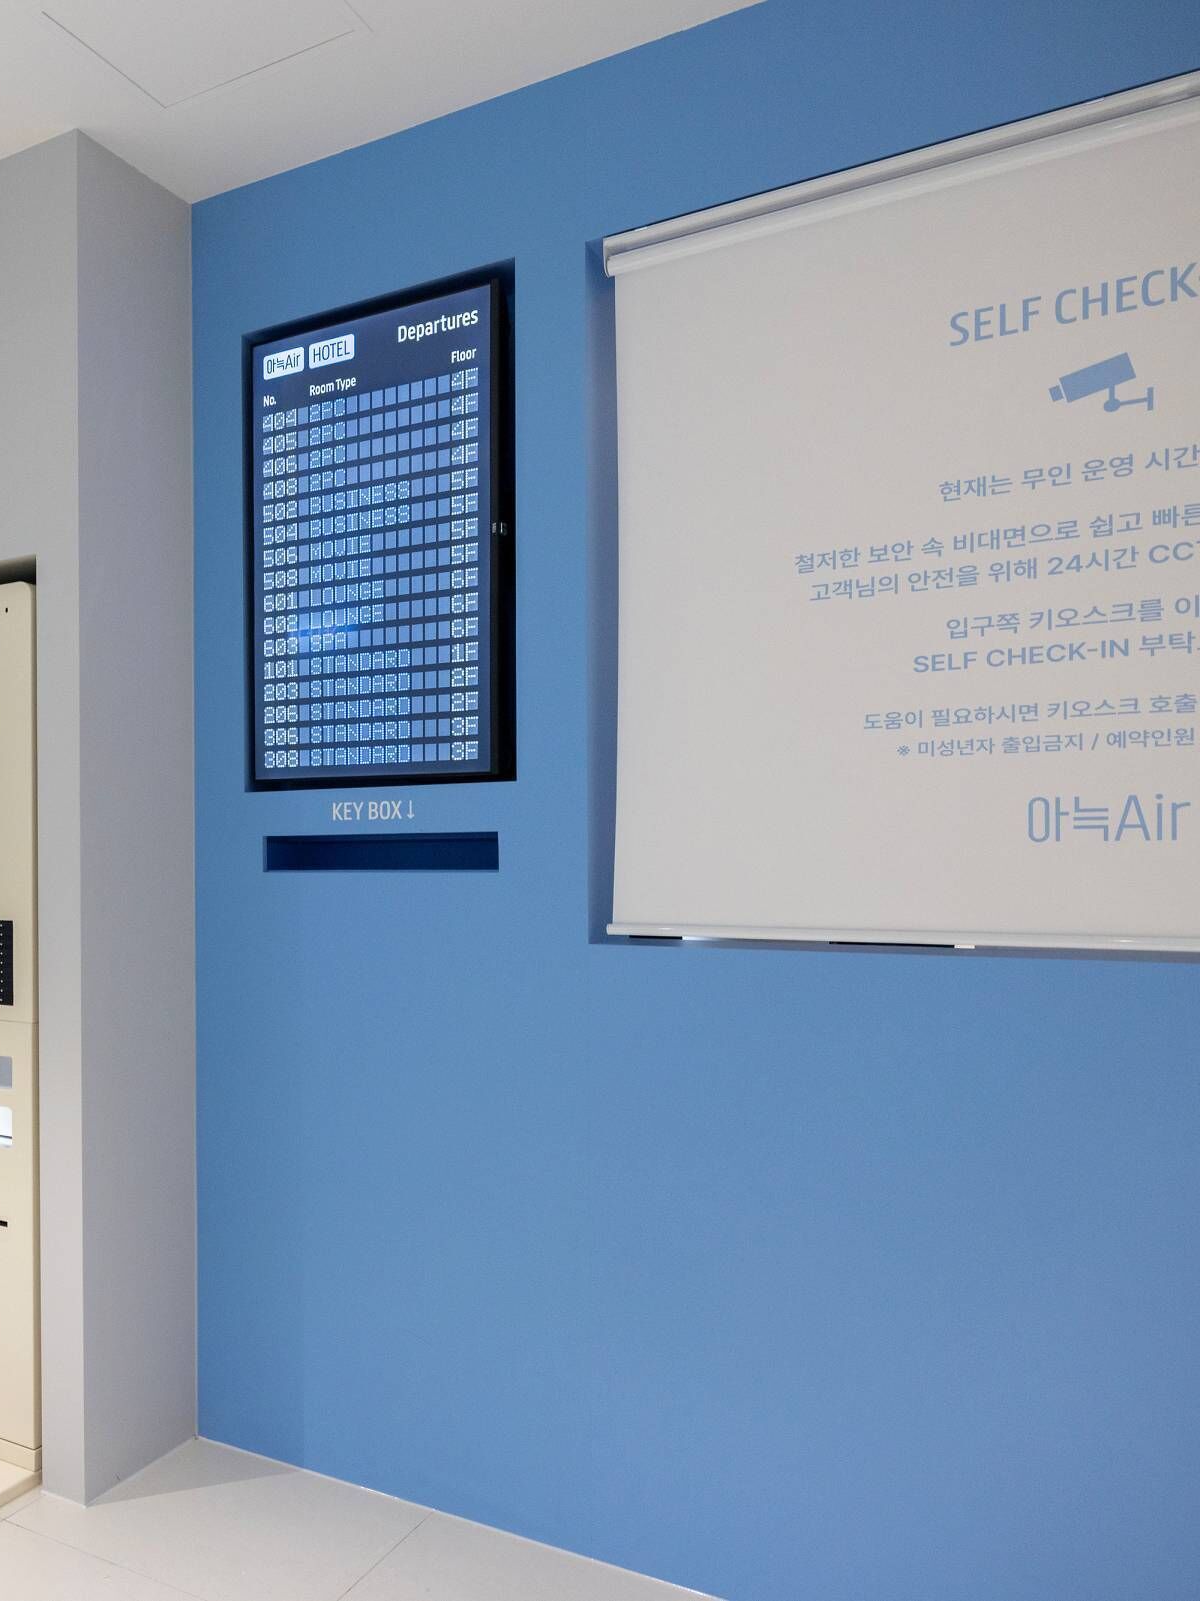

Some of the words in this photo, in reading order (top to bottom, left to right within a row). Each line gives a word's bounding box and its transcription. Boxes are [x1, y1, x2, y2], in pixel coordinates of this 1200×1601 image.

[949, 295, 1042, 348] SELF
[1054, 261, 1200, 326] CHECK
[397, 310, 479, 343] Departures
[312, 340, 351, 364] HOTEL
[451, 348, 477, 364] Floor
[263, 408, 298, 432] 404
[310, 398, 346, 422] 2PC
[451, 368, 479, 389] 4F
[263, 395, 277, 407] No.
[309, 382, 335, 396] Room
[335, 377, 357, 391] Type
[263, 432, 298, 455] 405
[310, 421, 346, 445] 2PC
[451, 392, 479, 413] 4F
[263, 455, 298, 477] 406
[310, 445, 346, 468] 2PC
[451, 417, 479, 439] 4F
[263, 478, 298, 500] 408
[310, 469, 346, 491] 2PC
[451, 442, 479, 464] 4F
[938, 473, 1013, 503] 현재는
[1021, 462, 1071, 491] 무인
[1080, 452, 1135, 482] 운영
[263, 500, 298, 522] 502
[310, 480, 410, 514] BUSINESS
[451, 467, 479, 489] 5F
[263, 523, 298, 545] 504
[310, 504, 410, 538] BUSINESS
[451, 493, 479, 514] 5F
[263, 546, 298, 568] 506
[310, 535, 371, 561] MOVIE
[451, 517, 479, 539] 5F
[794, 546, 860, 576] 철저한
[867, 540, 914, 565] 보안
[920, 535, 946, 558] 속
[952, 519, 1080, 553] 비대면으로
[1089, 510, 1143, 539] 쉽고
[263, 569, 298, 590] 508
[310, 558, 371, 584] MOVIE
[451, 543, 479, 564] 5F
[809, 573, 900, 603] 고객님의
[907, 563, 980, 592] 안전을
[988, 556, 1038, 584] 위해
[1046, 544, 1139, 577] 24시간
[1148, 538, 1200, 566] CC
[263, 592, 298, 612] 601
[310, 580, 384, 606] LOUNGE
[451, 568, 479, 589] 6F
[263, 614, 298, 634] 602
[310, 604, 384, 629] LOUNGE
[451, 592, 479, 613] 6F
[946, 611, 1021, 640] 입구쪽
[1028, 597, 1164, 631] 키오스크를
[263, 637, 298, 656] 603
[310, 632, 346, 652] SPA
[451, 617, 479, 638] 6F
[913, 650, 978, 674] SELF
[986, 637, 1130, 668] CHECK-IN
[1138, 630, 1200, 656] 부탁
[263, 660, 298, 679] 101
[310, 648, 410, 674] STANDARD
[451, 642, 479, 662] 1F
[263, 682, 298, 701] 203
[310, 673, 410, 697] STANDARD
[451, 666, 479, 687] 2F
[263, 705, 298, 724] 206
[310, 696, 410, 720] STANDARD
[451, 692, 479, 712] 2F
[863, 708, 924, 731] 도움이
[931, 700, 1040, 729] 필요하시면
[1047, 697, 1142, 721] 키오스크
[1149, 692, 1199, 715] 호출
[263, 727, 298, 746] 306
[310, 720, 410, 743] STANDARD
[451, 716, 479, 736] 3F
[917, 738, 995, 758] 미성년자
[1002, 734, 1084, 756] 출입금지
[1106, 726, 1196, 750] 예약인원
[263, 750, 298, 768] 308
[310, 744, 410, 766] STANDARD
[451, 741, 479, 761] 3F
[332, 802, 364, 821] KEY
[368, 800, 403, 821] BOX
